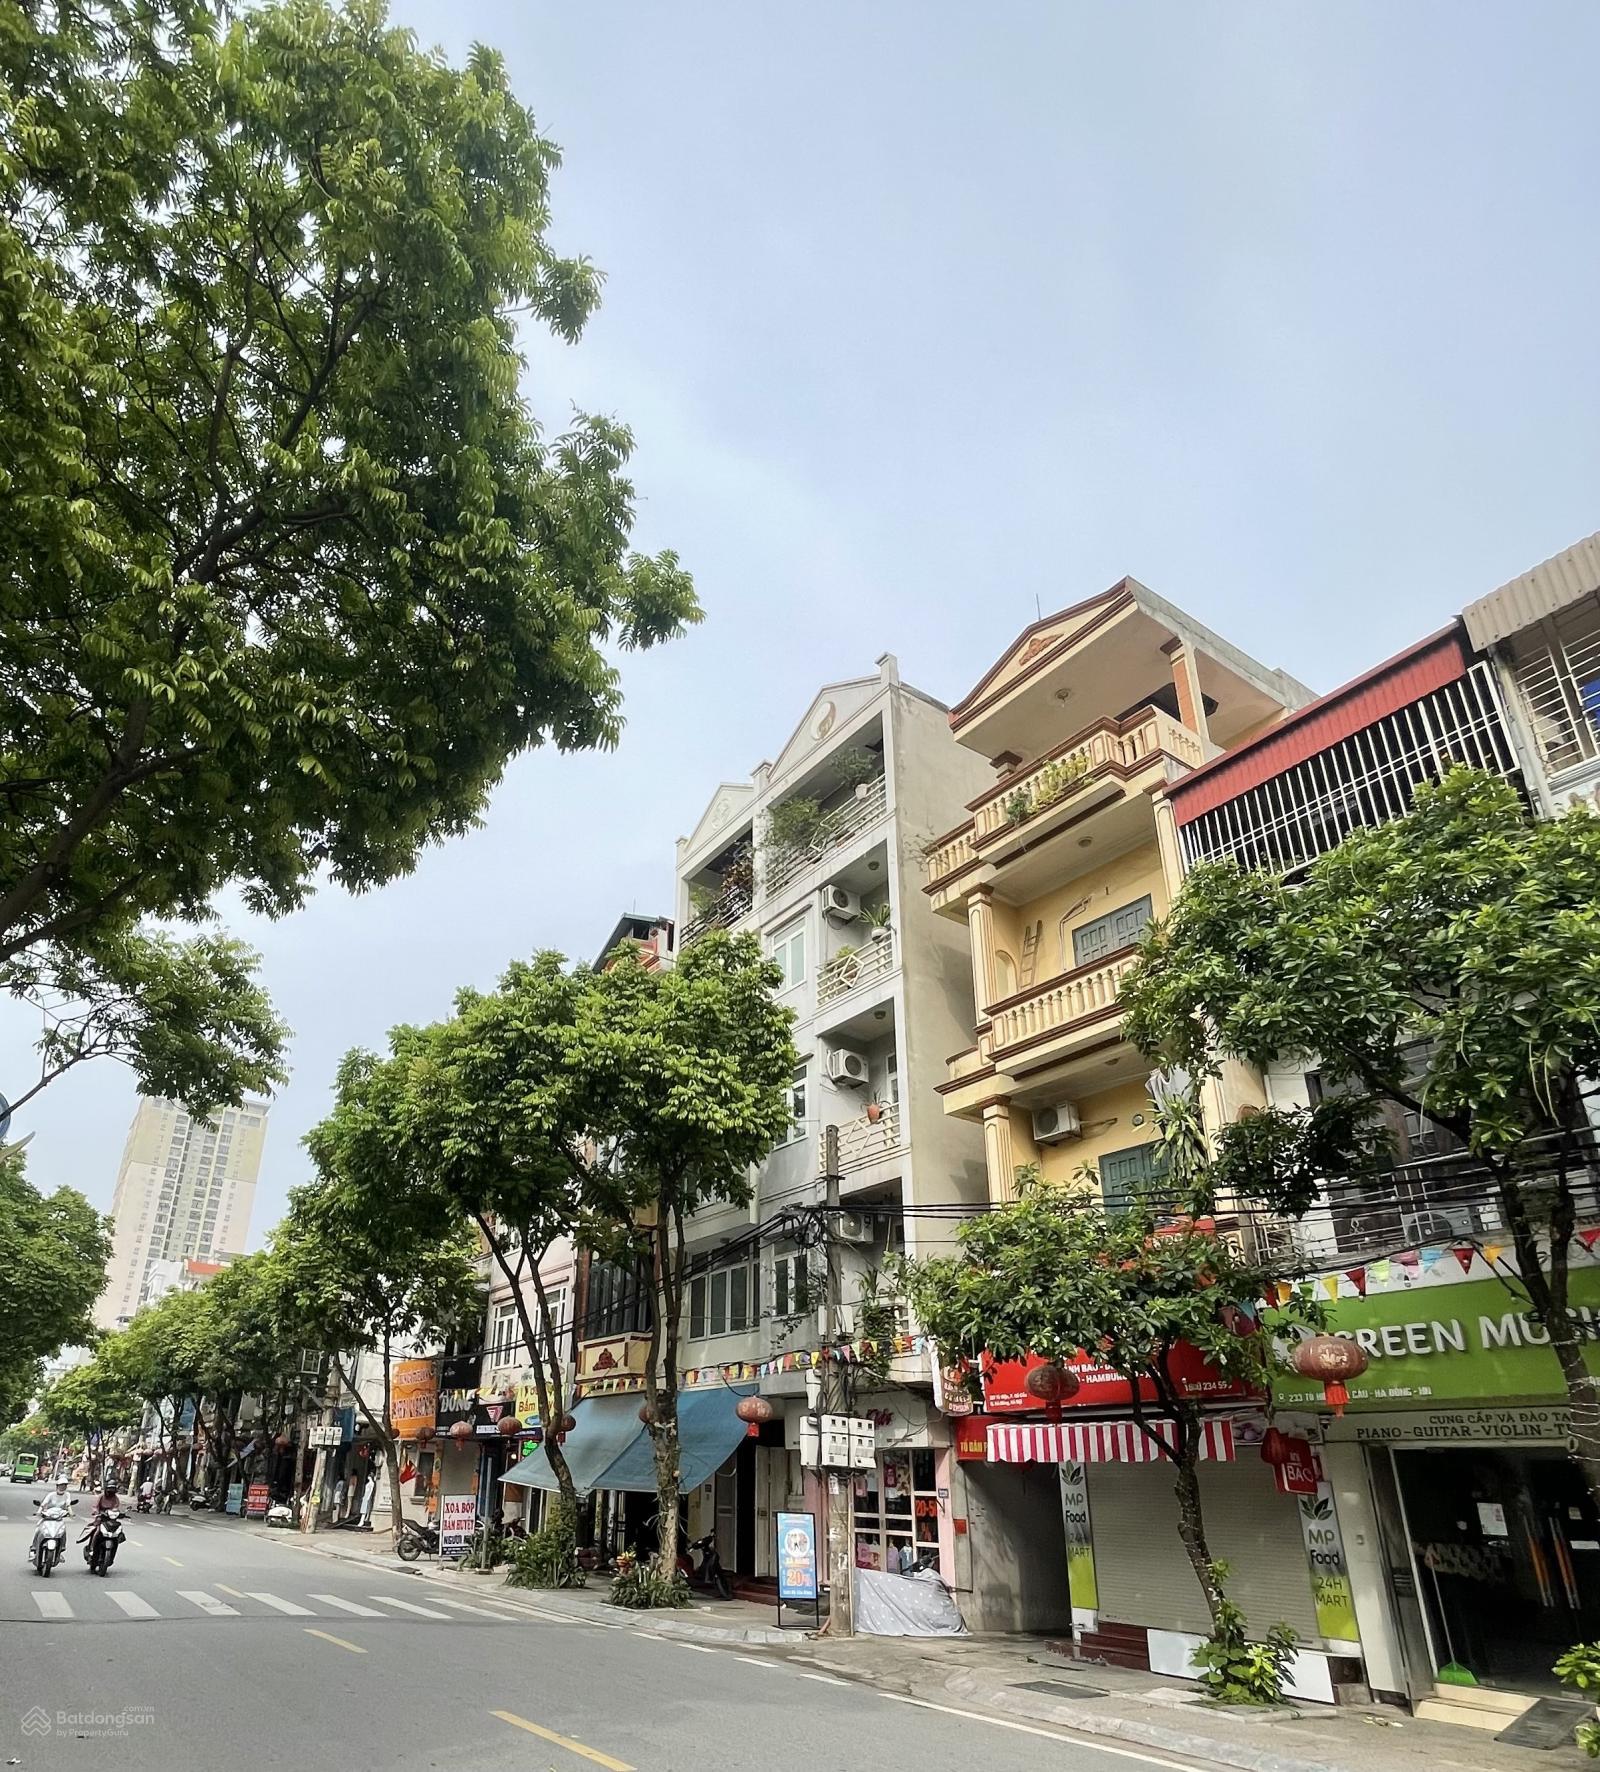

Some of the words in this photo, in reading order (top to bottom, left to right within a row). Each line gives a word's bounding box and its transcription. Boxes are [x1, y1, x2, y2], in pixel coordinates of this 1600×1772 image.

[1336, 1319, 1467, 1358] REEN
[1429, 1415, 1464, 1425] CUNG
[1468, 1411, 1493, 1424] CẤP
[1498, 1410, 1516, 1423] VÀ
[1520, 1409, 1548, 1423] ĐÀO
[1065, 1509, 1087, 1524] Food
[1067, 1547, 1090, 1558] MART
[1310, 1550, 1341, 1566] Food
[1318, 1576, 1343, 1590] 24H
[1315, 1593, 1348, 1609] MART
